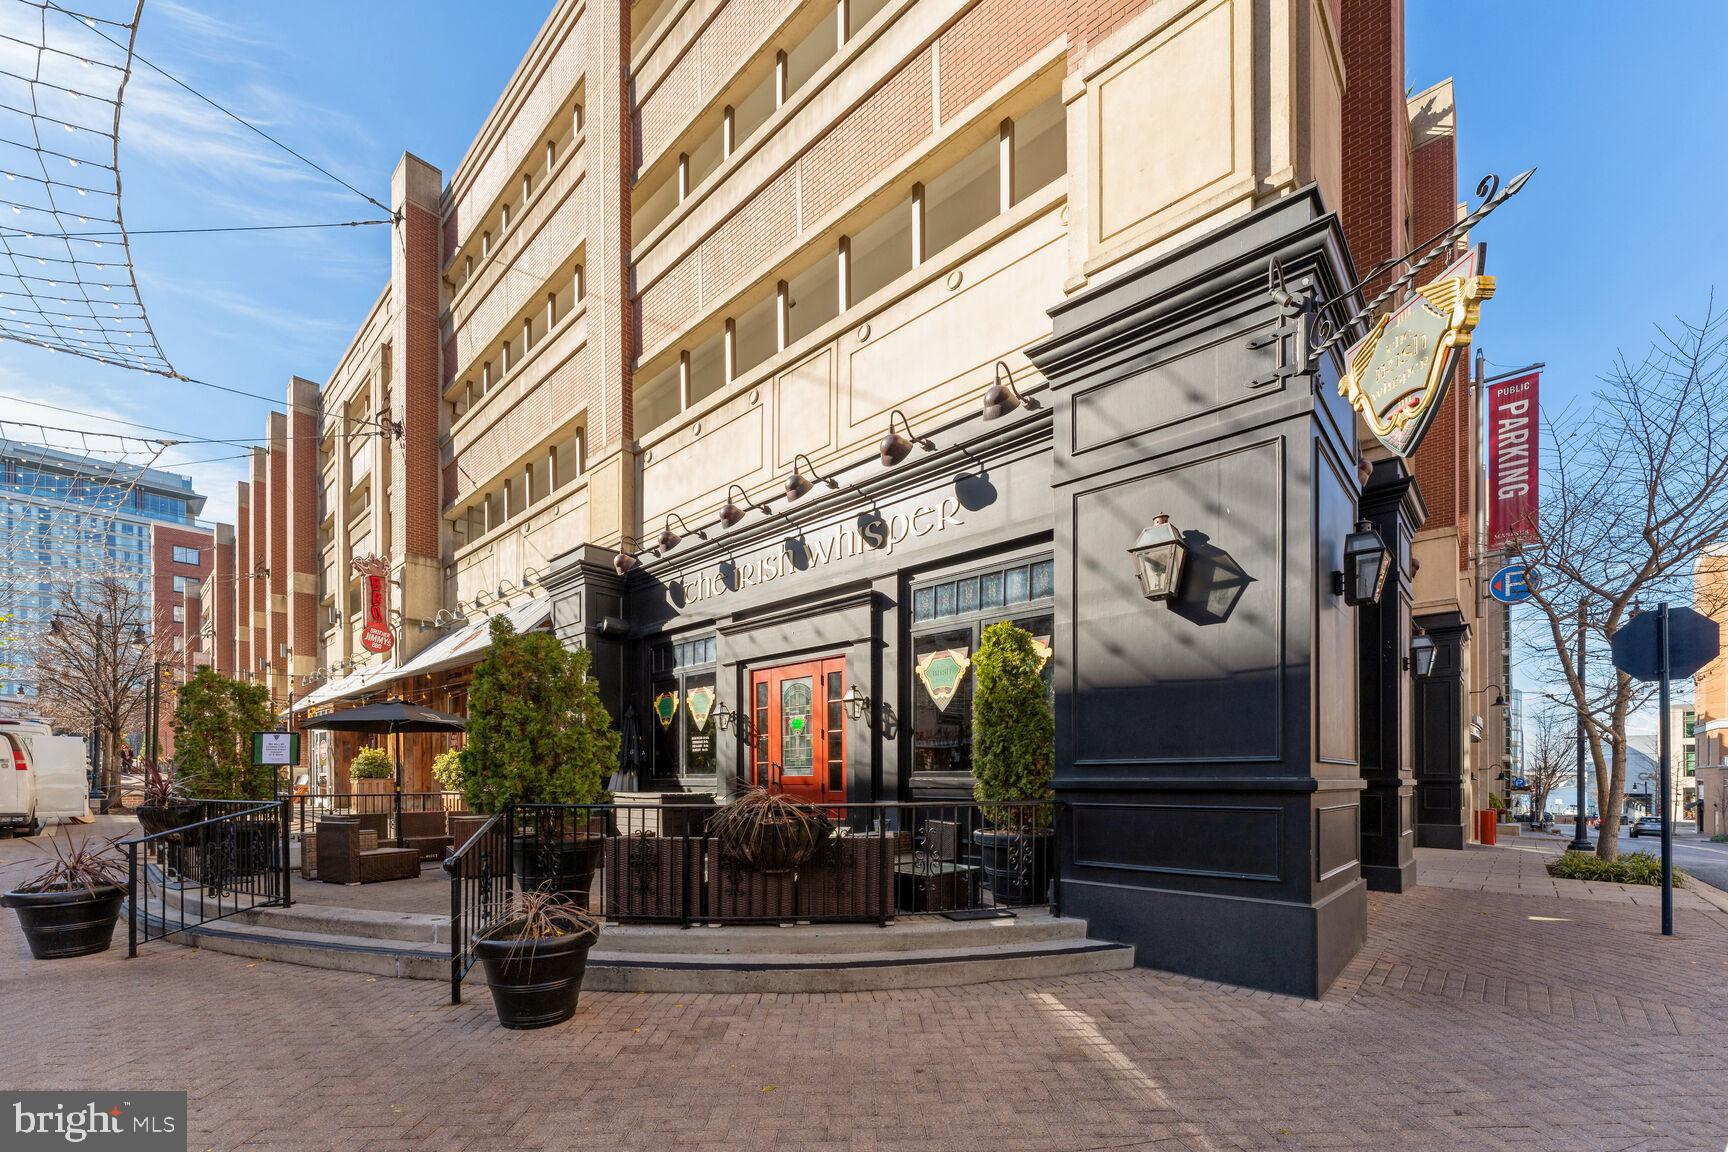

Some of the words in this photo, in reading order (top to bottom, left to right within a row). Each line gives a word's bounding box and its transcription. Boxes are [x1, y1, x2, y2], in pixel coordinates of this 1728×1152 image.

[1497, 381, 1530, 398] PUBLIC
[1498, 399, 1529, 500] PARKING
[370, 576, 383, 620] BBQ
